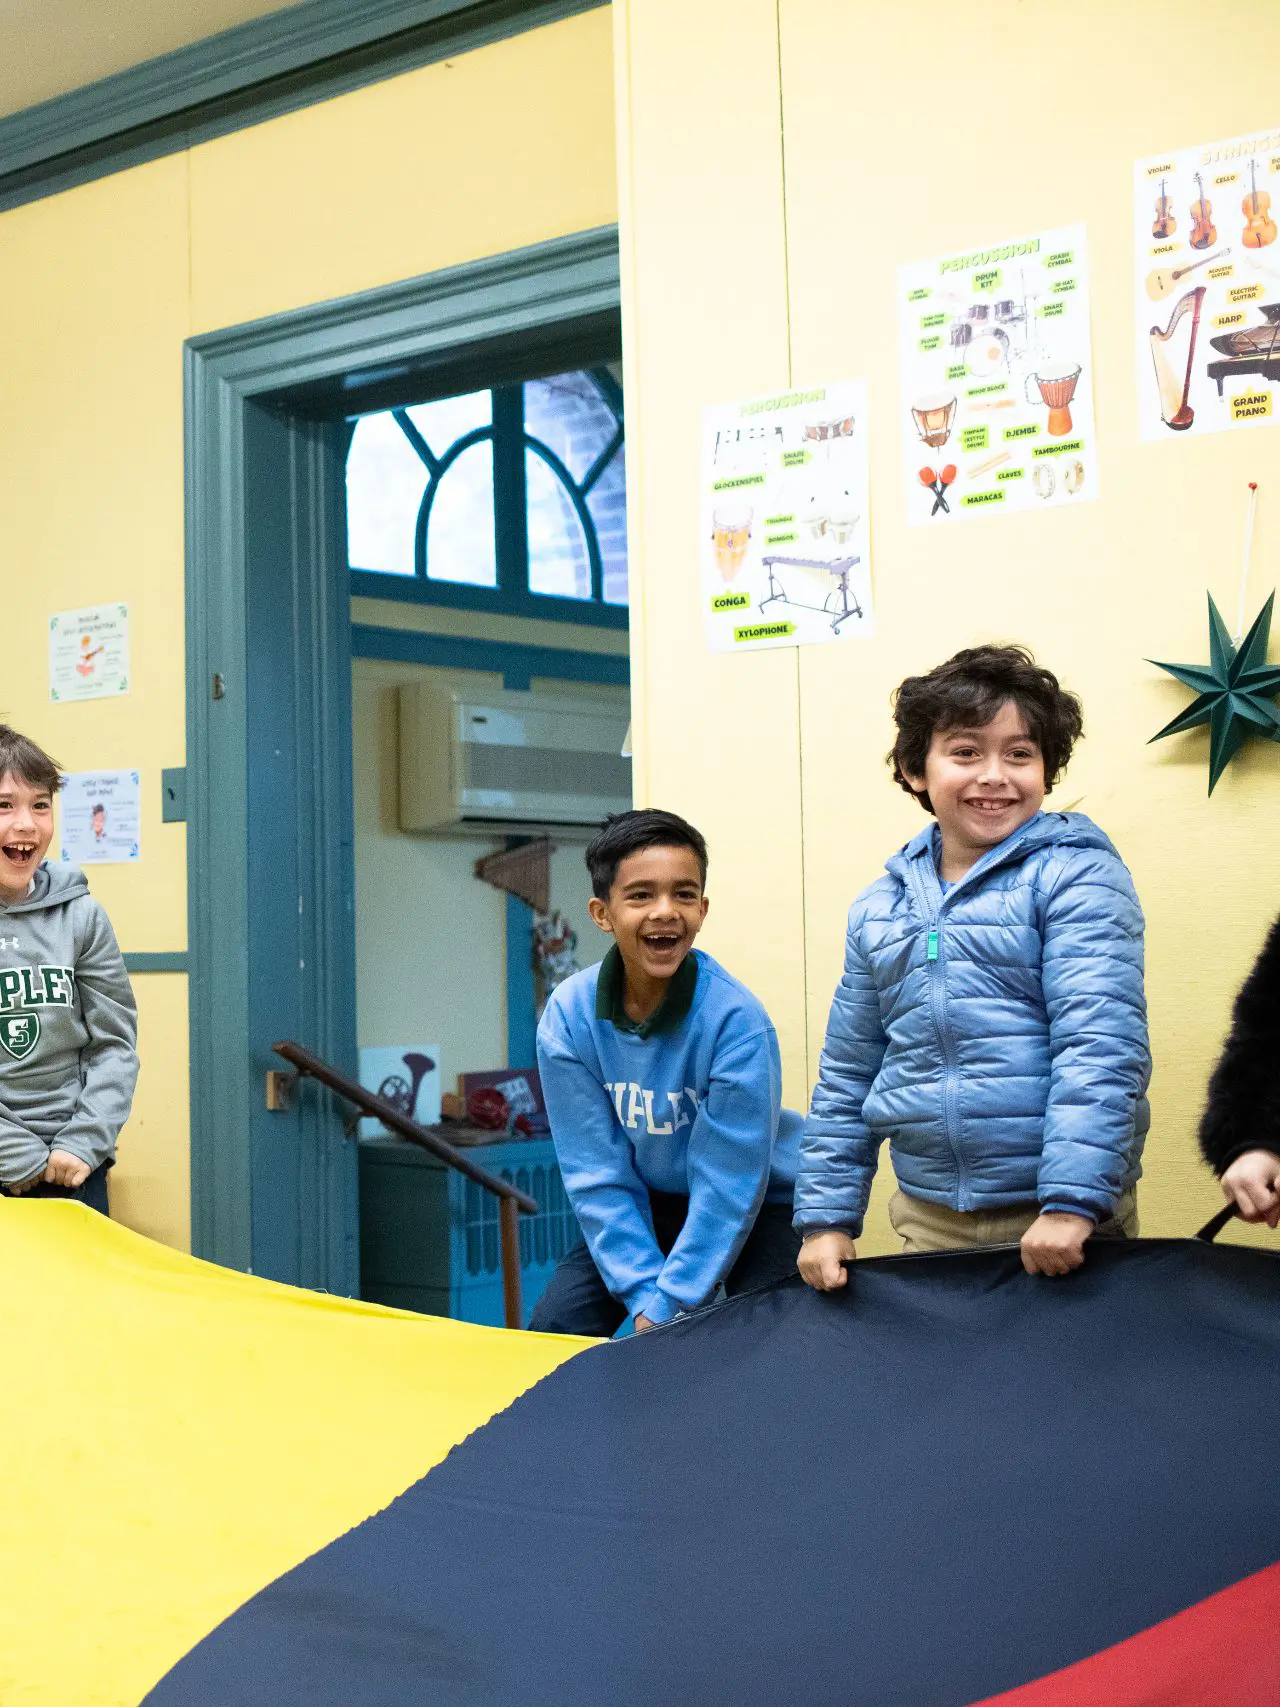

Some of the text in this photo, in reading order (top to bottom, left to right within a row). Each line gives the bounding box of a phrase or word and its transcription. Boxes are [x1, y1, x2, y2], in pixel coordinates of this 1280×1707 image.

[1148, 164, 1171, 175] VIOLIN
[1215, 175, 1235, 184] CELLO
[1153, 245, 1173, 254] VIOLA
[940, 239, 1040, 276] PERCUSSION
[1048, 257, 1072, 268] CYMBAL
[975, 271, 998, 282] DRUM
[980, 279, 993, 289] KIT
[1230, 286, 1258, 296] ELECTRIC
[1232, 291, 1256, 302] GUITAR
[1043, 302, 1063, 312] SNARE
[1044, 309, 1062, 318] DRUM
[1218, 314, 1242, 325] HARP
[968, 383, 1005, 396] WOOD BLOCK
[1233, 395, 1267, 408] GRAND
[1235, 406, 1266, 418] PIANO
[1006, 425, 1037, 438] DJEMBE
[1034, 442, 1080, 457] TAMBOURINE
[998, 470, 1021, 480] CLAVES
[714, 475, 764, 490] GLOCKENSPIEL
[967, 492, 1003, 504] MARACAS
[714, 596, 746, 608] CONGA
[738, 624, 788, 638] XYLOPHONE
[8, 1018, 29, 1048] S
